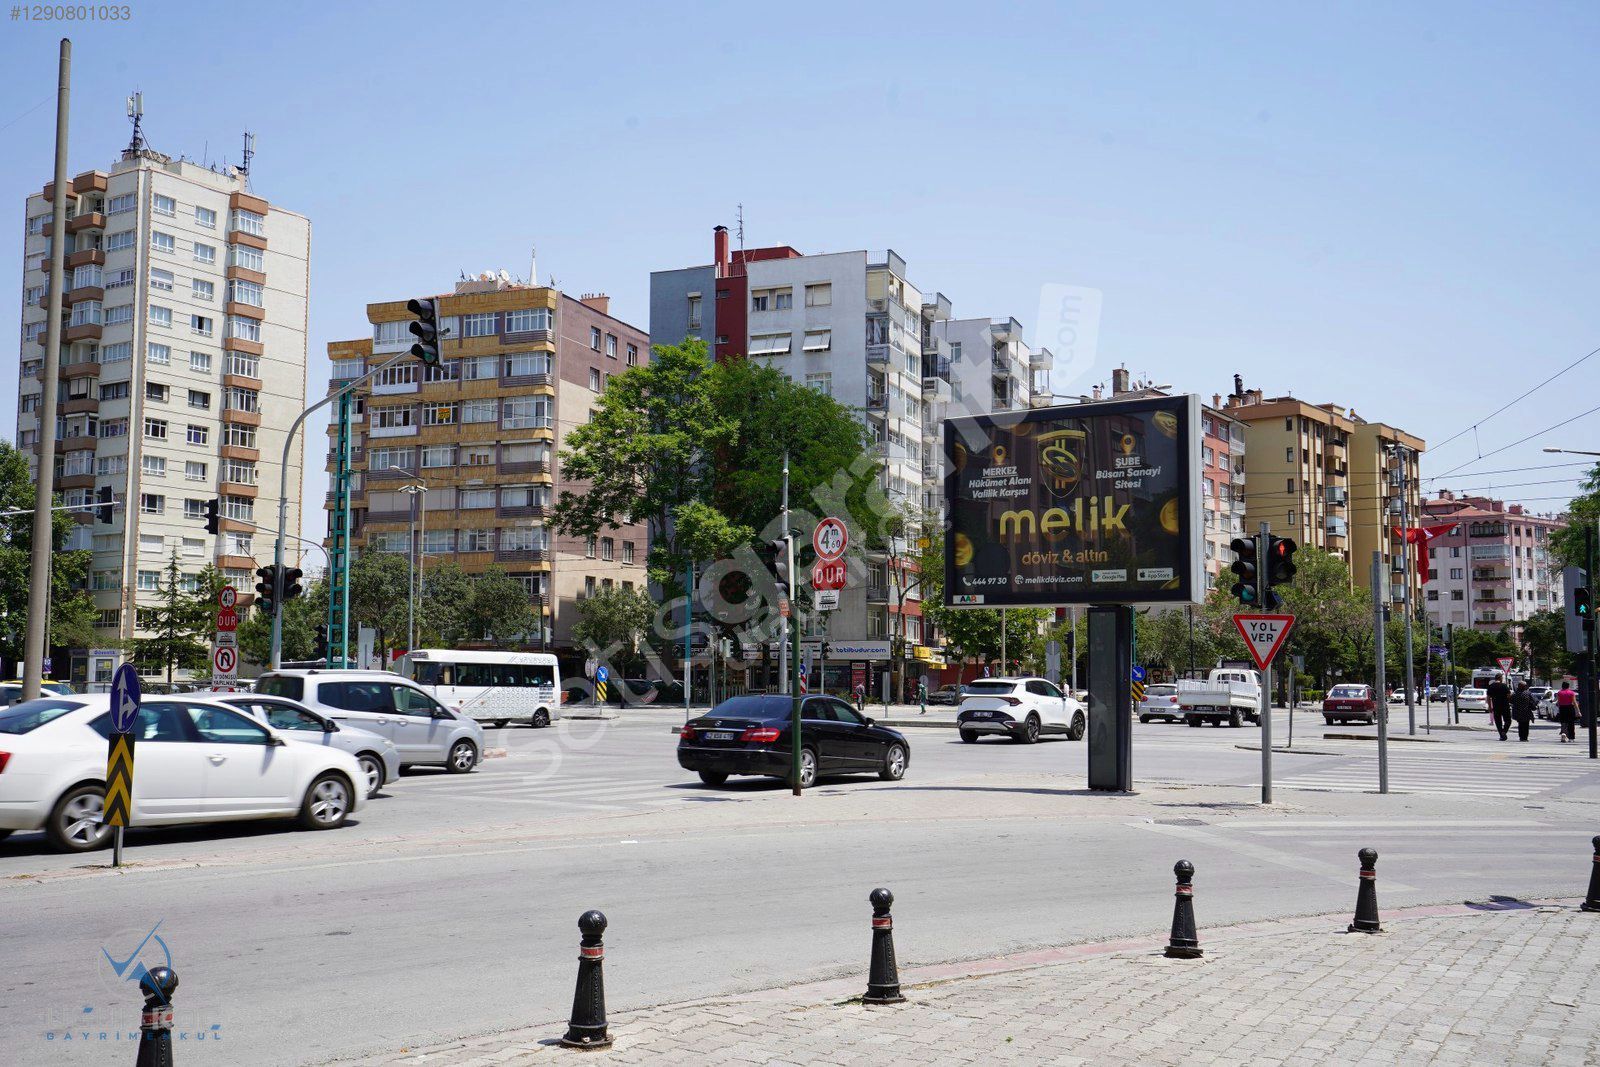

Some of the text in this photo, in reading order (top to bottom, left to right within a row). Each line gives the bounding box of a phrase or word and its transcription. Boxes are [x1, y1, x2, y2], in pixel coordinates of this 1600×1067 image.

[1115, 456, 1141, 467] ŞUBE
[982, 466, 1018, 476] MERKEZ
[1096, 466, 1161, 479] Büsan Sanayi
[968, 477, 1032, 489] Hükümet Alanı
[1114, 479, 1142, 489] Sitesi
[972, 488, 1029, 499] Valilik Karşısı
[1000, 495, 1132, 543] melik
[821, 530, 829, 549] 4
[1021, 548, 1109, 566] döviz & altın
[815, 567, 844, 584] DUR
[1025, 575, 1083, 584] melikdöviz.com
[972, 577, 1007, 586] 444 97 30
[218, 615, 236, 626] DUR
[1250, 622, 1277, 632] YOL
[1250, 633, 1274, 642] VER
